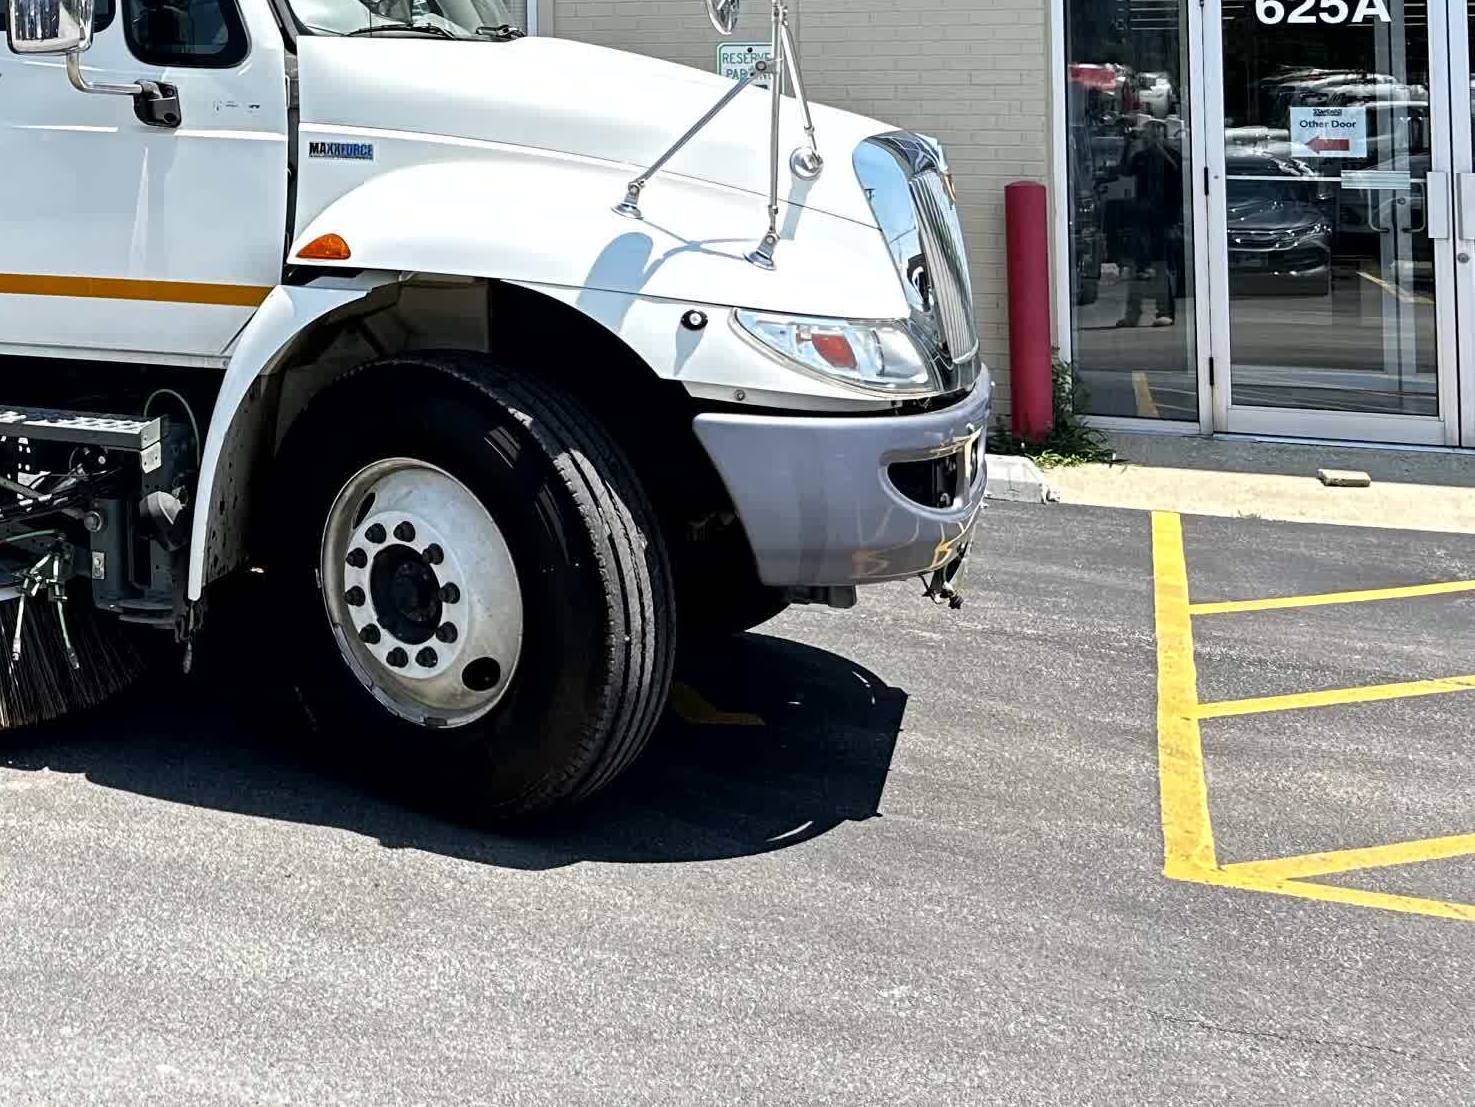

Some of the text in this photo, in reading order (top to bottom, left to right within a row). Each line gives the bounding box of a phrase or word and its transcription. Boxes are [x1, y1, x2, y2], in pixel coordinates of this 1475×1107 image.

[722, 52, 772, 64] RESERVE
[1299, 119, 1357, 129] Other Door
